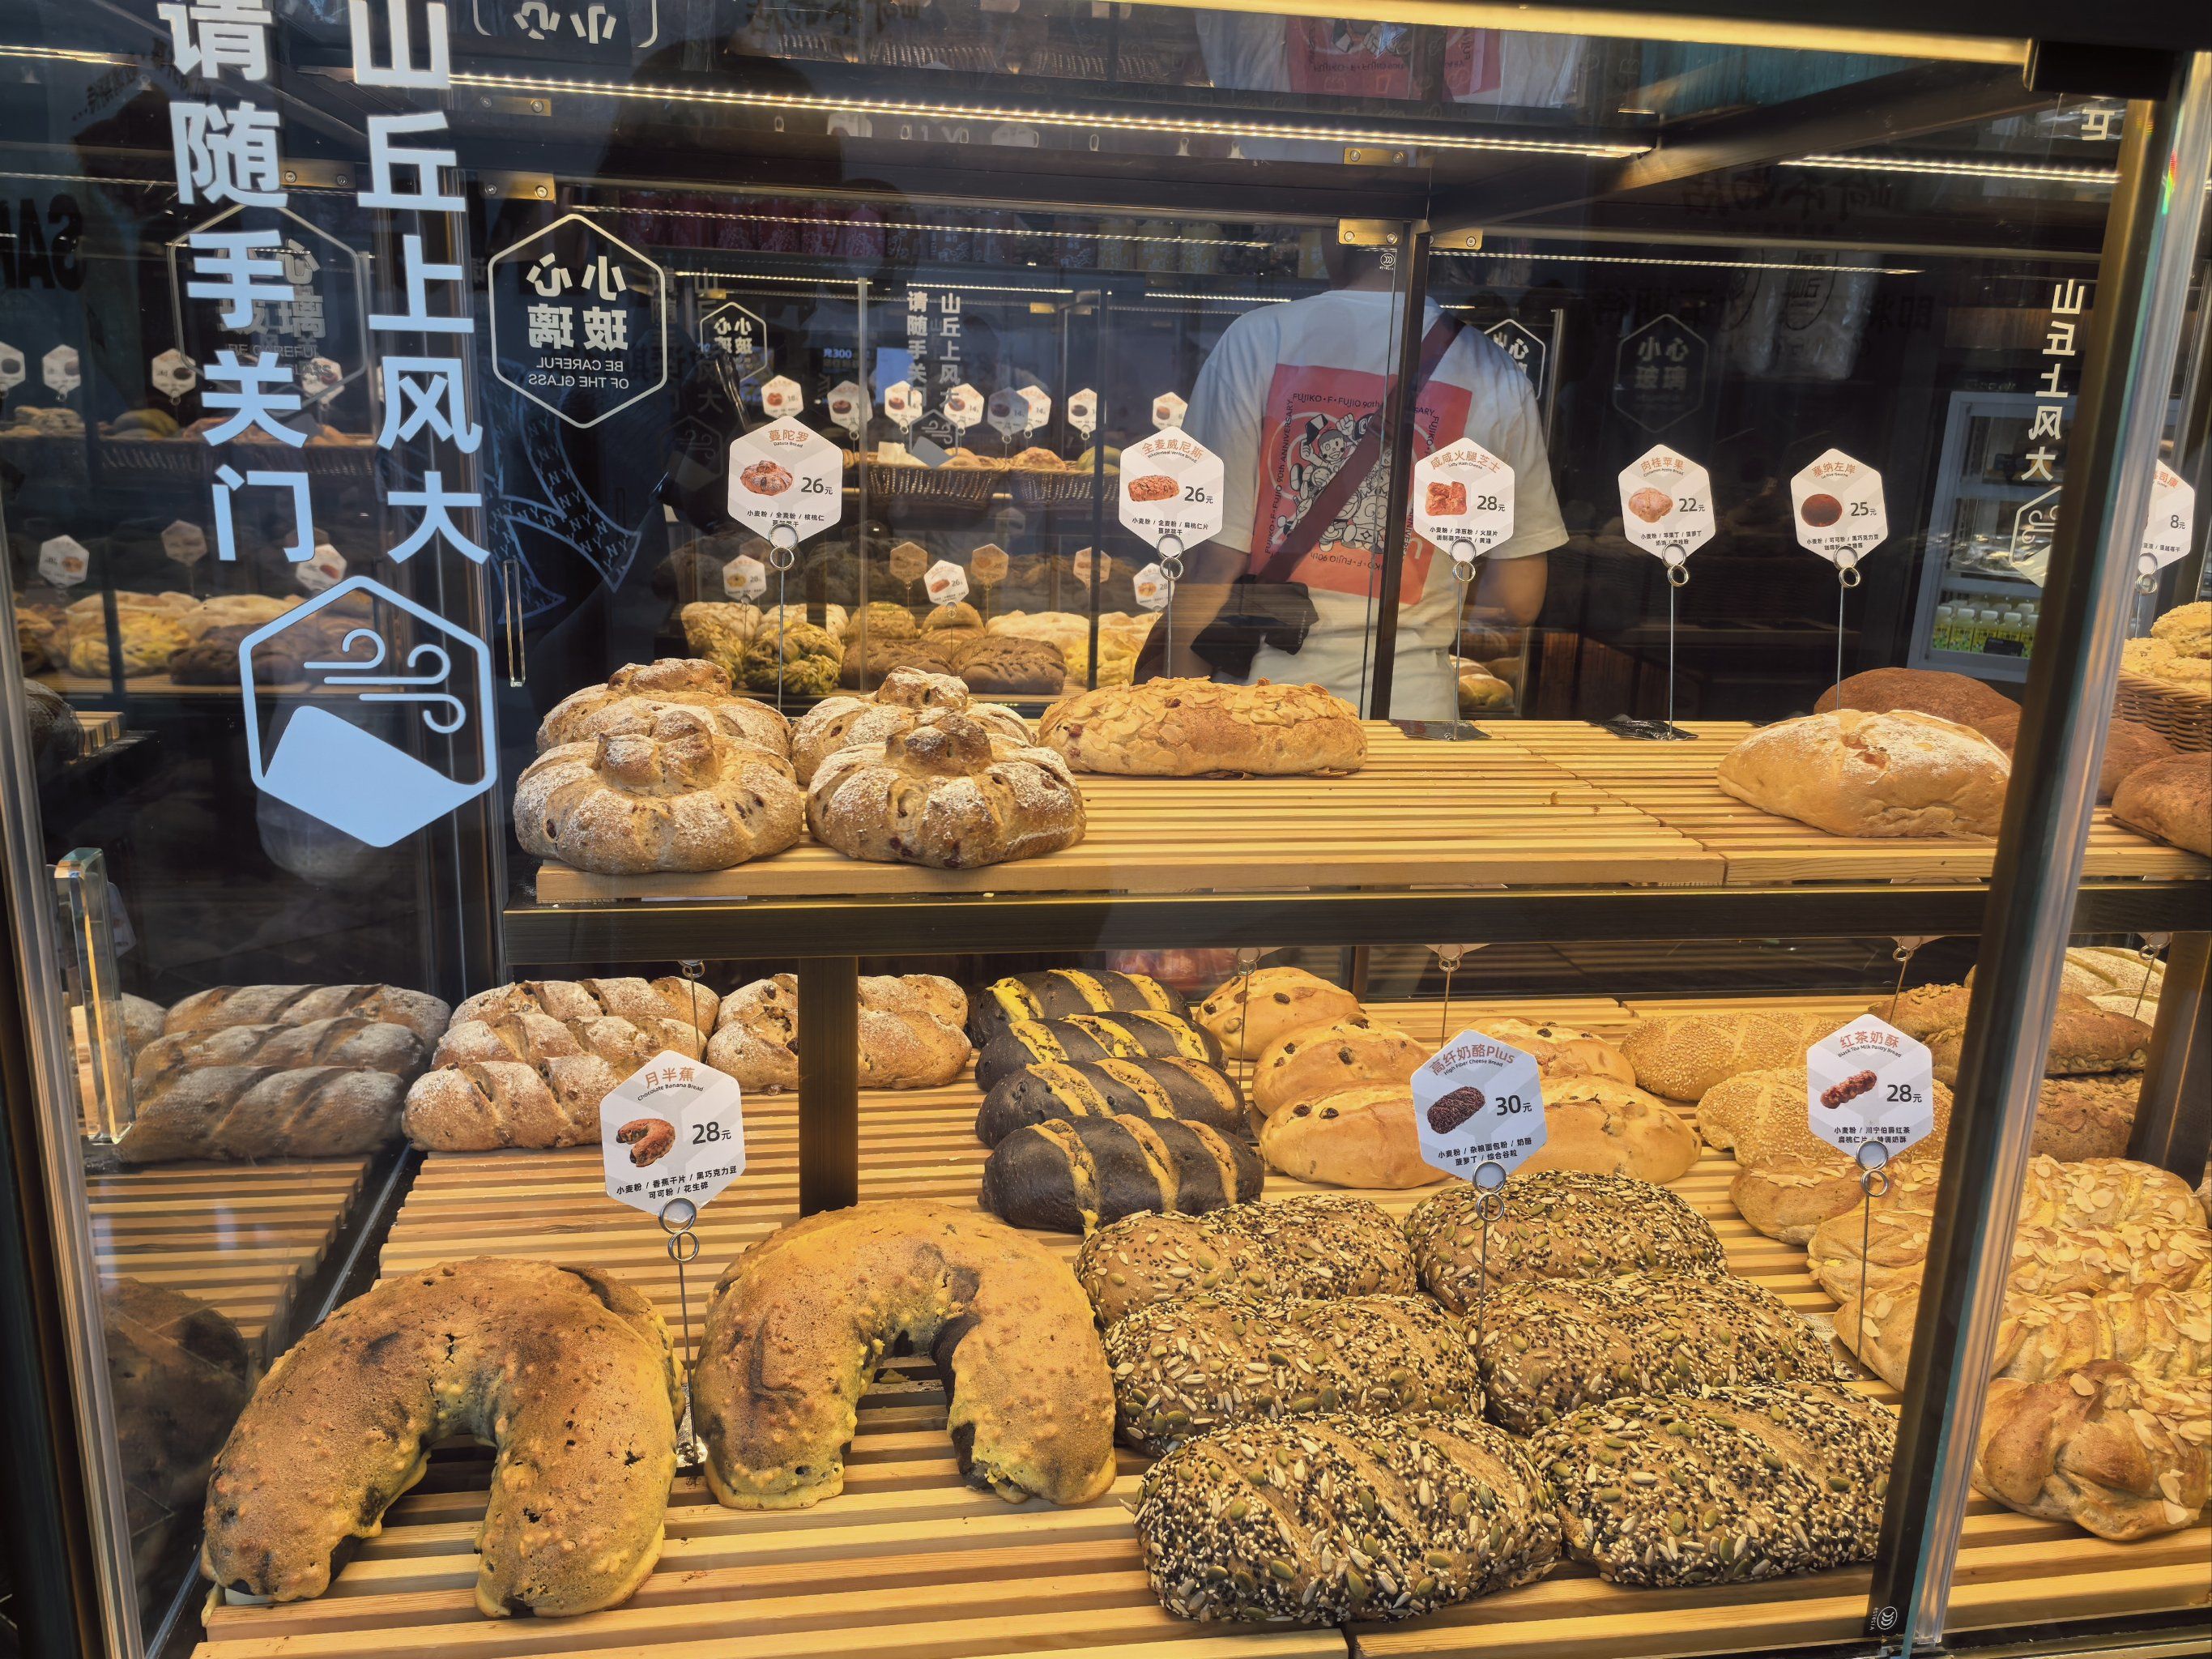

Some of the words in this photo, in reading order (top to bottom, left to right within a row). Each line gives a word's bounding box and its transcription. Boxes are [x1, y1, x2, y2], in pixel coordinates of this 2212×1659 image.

[157, 0, 315, 562] 请随手关门
[350, 0, 490, 565] 山丘上风大
[1293, 393, 1322, 403] FUJIKO
[1338, 397, 1361, 407] FUJIO
[1281, 399, 1294, 463] ANNIVERSARY
[1142, 439, 1204, 459] 全麦威尼斯
[1430, 450, 1501, 473] 咸咸火腿芝士
[1641, 457, 1684, 471] 肉桂苹果
[1812, 462, 1856, 477] 塞纳左岸
[801, 477, 833, 495] 26元
[1184, 486, 1213, 504] 26元
[1477, 496, 1505, 512] 28元
[1679, 498, 1705, 512] 22元
[1851, 502, 1877, 516] 25元
[2171, 514, 2185, 530] 8元
[1839, 1030, 1899, 1048] 红茶奶酥
[1430, 1043, 1515, 1076] 高纤奶酪Plus
[1838, 1049, 1851, 1058] Black
[1871, 1044, 1887, 1052] Pastry
[1887, 1048, 1902, 1058] Bread
[1444, 1065, 1457, 1076] High
[1488, 1059, 1503, 1068] Bread
[645, 1066, 696, 1089] 月半蕉
[637, 1085, 664, 1101] Chocolate
[688, 1083, 704, 1092] Bread
[1886, 1084, 1922, 1103] 28元
[1495, 1094, 1532, 1116] 30元
[692, 1121, 731, 1145] 28元
[1865, 1126, 1911, 1134] 川宁伯爵红茶
[1438, 1149, 1460, 1159] 小麦粉
[1470, 1141, 1507, 1154] 杂粮面包粉
[1487, 1150, 1517, 1161] 综合谷粒
[616, 1183, 642, 1195] 小麦粉
[652, 1175, 686, 1188] 香蕉干片
[697, 1165, 737, 1180] 黑巧克力豆
[648, 1188, 674, 1199] 可可粉
[684, 1181, 709, 1193] 花生碎
